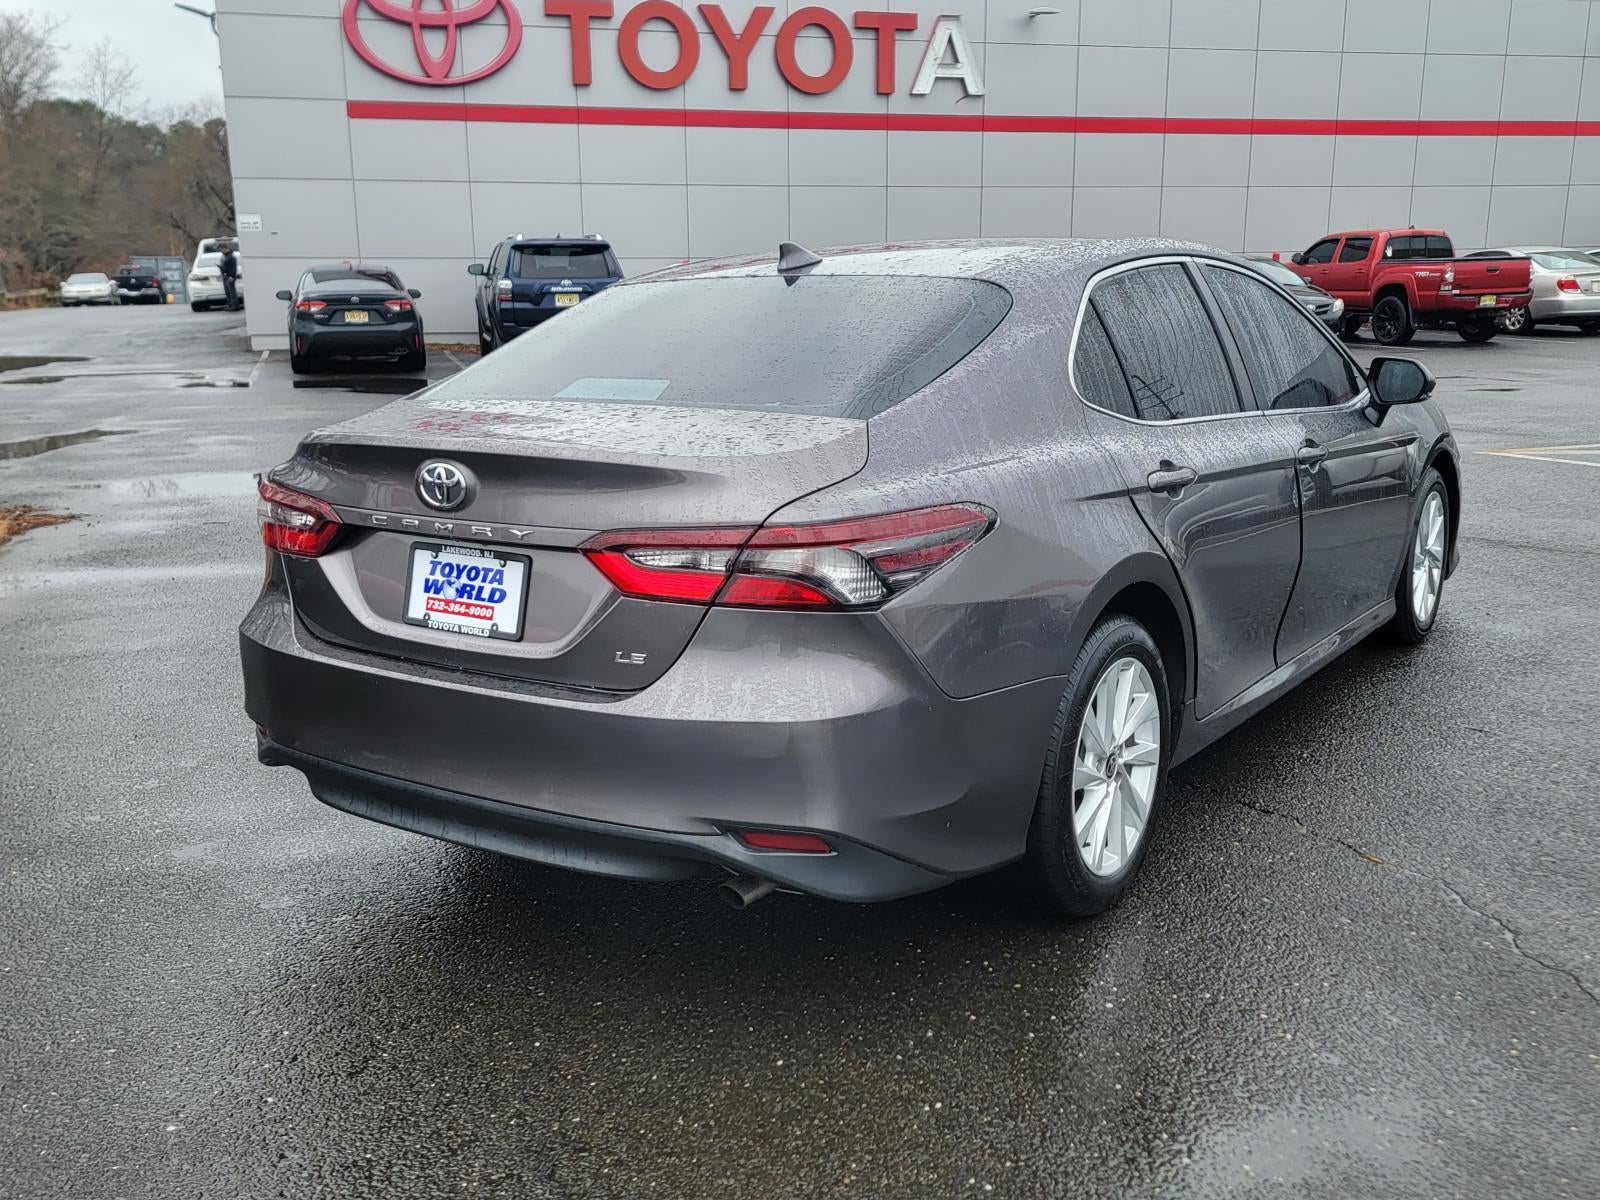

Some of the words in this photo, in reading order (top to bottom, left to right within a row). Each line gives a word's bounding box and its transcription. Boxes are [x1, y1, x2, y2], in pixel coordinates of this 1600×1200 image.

[545, 0, 986, 97] TOYOTA
[371, 515, 536, 540] CAMRY
[484, 551, 494, 559] NJ
[429, 560, 504, 585] TOYOTA
[427, 600, 492, 618] 732-364-9000
[428, 620, 459, 632] TOYOTA
[461, 626, 490, 637] WORLD
[614, 651, 647, 664] LE
